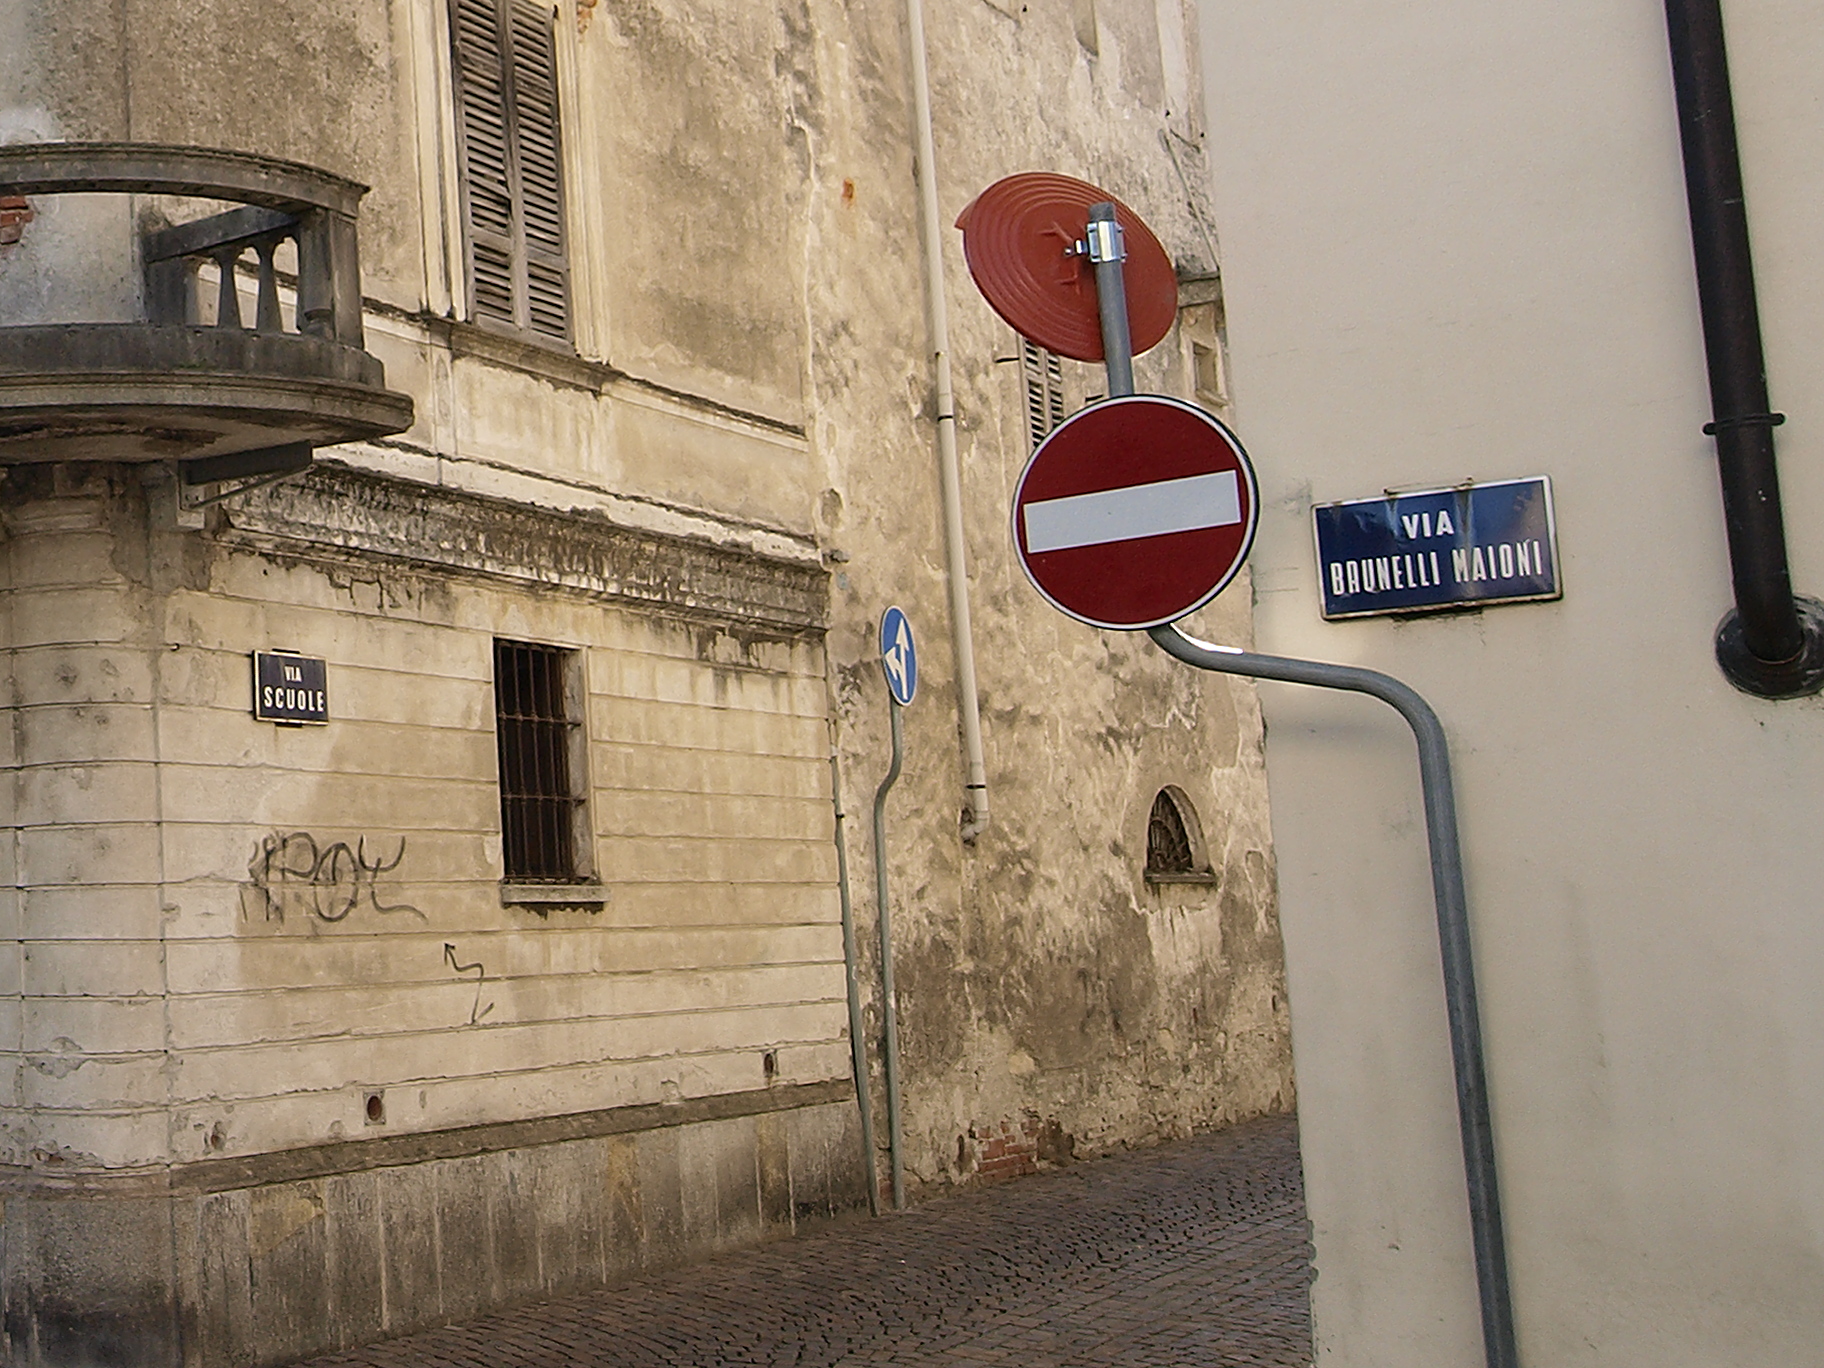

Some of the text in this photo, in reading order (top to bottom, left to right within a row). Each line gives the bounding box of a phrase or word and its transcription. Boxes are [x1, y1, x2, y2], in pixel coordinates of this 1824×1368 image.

[1401, 510, 1454, 539] VIA
[1330, 541, 1542, 596] BRUNELLI MAIONI
[284, 666, 302, 682] VIA
[263, 686, 324, 712] SCUOLE
